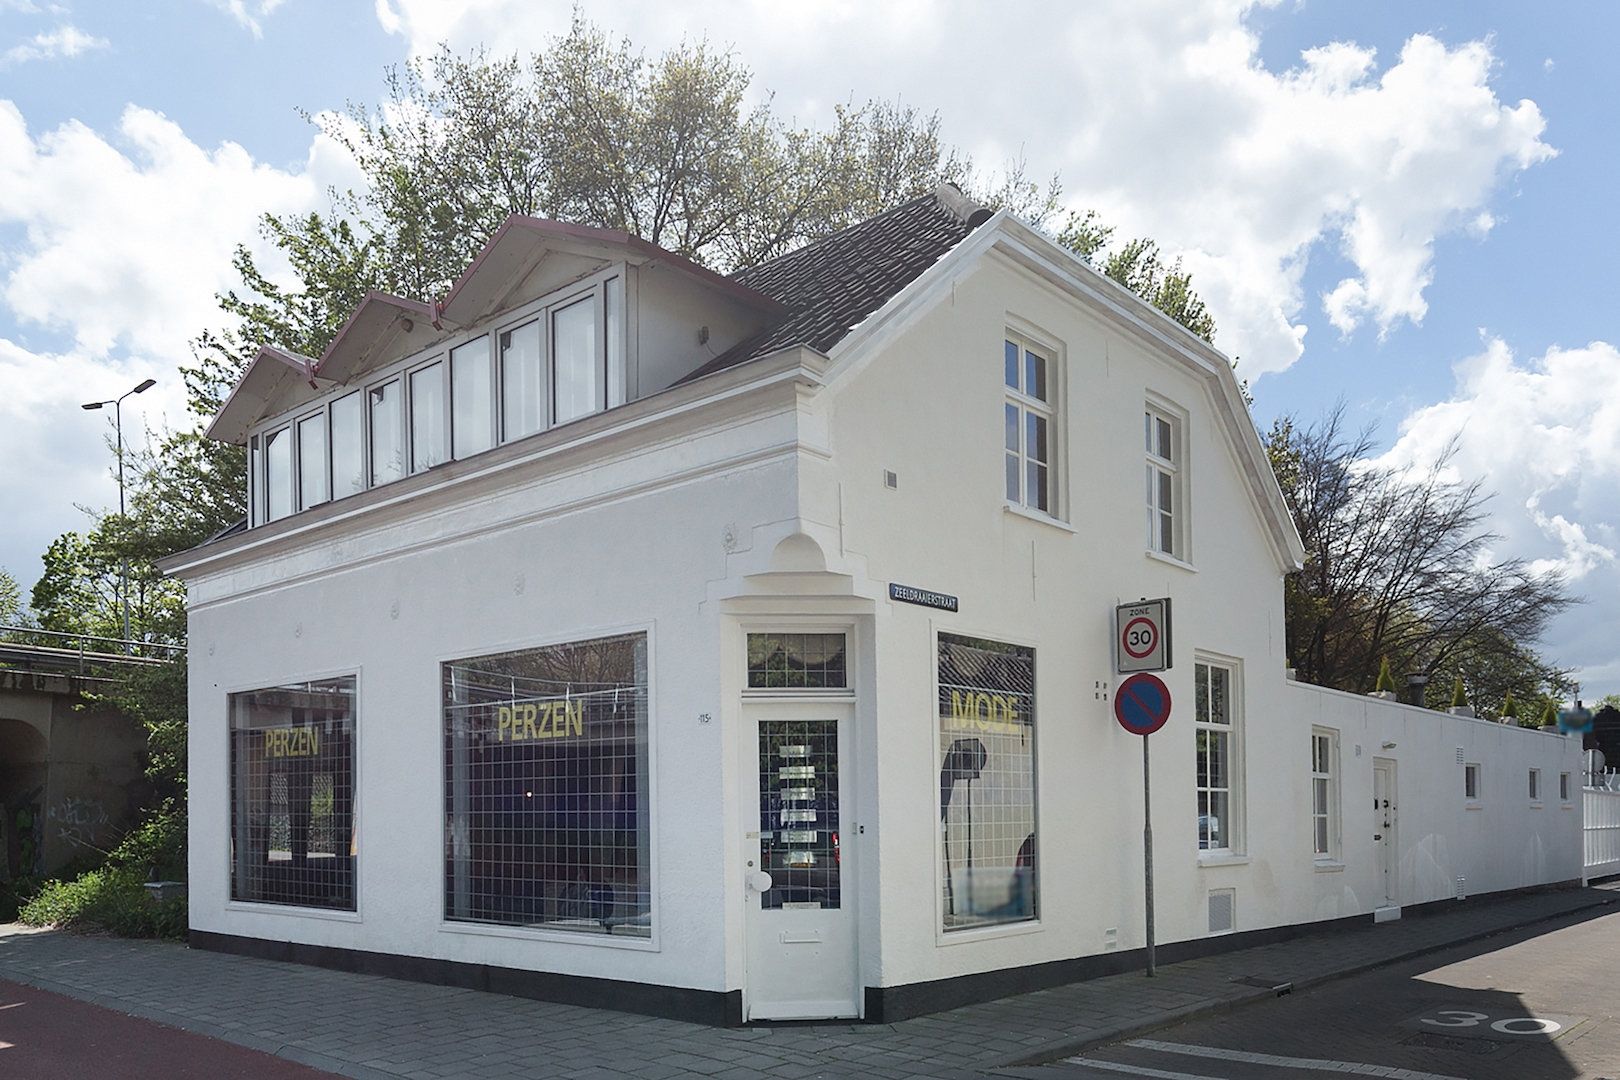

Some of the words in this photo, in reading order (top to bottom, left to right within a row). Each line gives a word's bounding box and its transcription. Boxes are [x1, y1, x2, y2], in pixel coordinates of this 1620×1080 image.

[894, 586, 957, 609] ZEELDRAAIERSTRAAT
[1129, 607, 1150, 616] ZONE
[1129, 630, 1151, 645] 30
[499, 698, 583, 741] PERZEN
[952, 690, 1019, 732] MODE
[265, 726, 319, 757] PERZEN
[1420, 1010, 1561, 1034] 30
